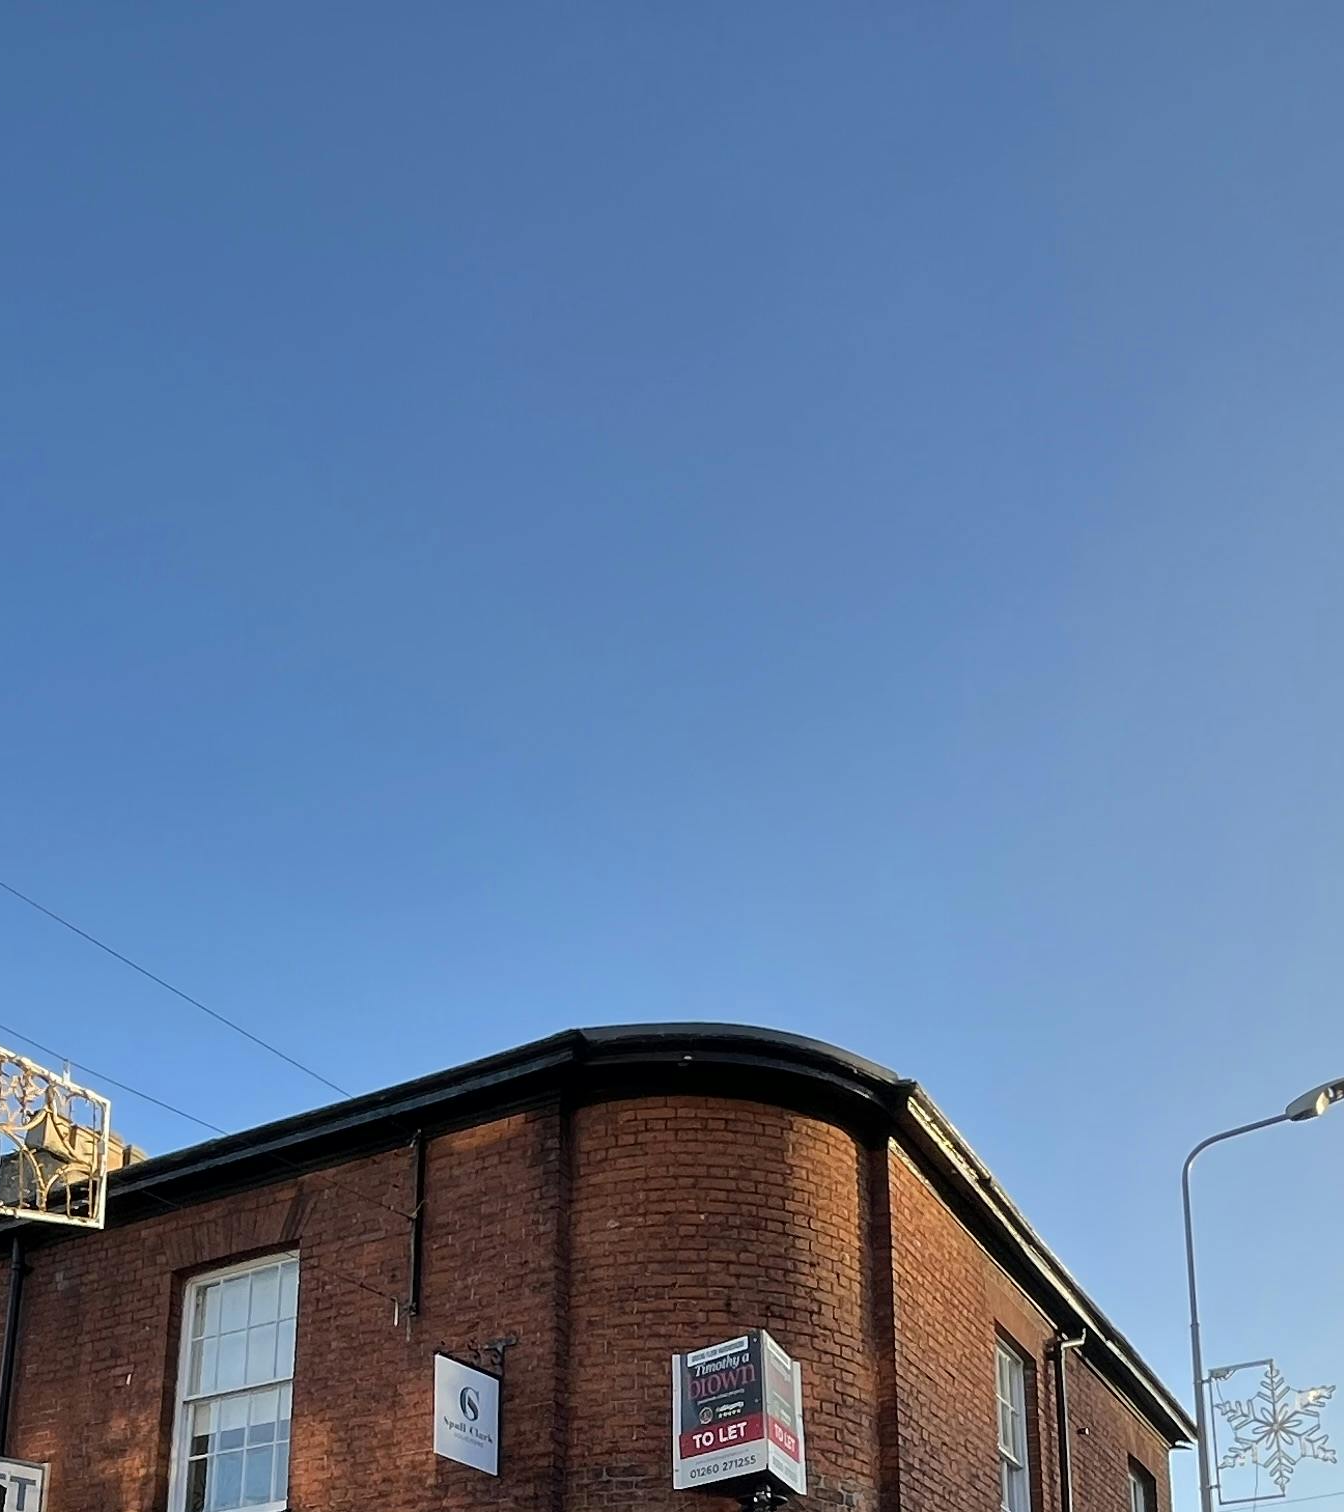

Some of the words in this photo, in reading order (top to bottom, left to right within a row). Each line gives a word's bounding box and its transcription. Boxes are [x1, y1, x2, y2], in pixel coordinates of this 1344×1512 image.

[694, 1354, 740, 1376] Timothy
[692, 1430, 714, 1449] TO
[719, 1421, 748, 1443] LET
[774, 1423, 783, 1442] TO
[784, 1431, 796, 1452] LET
[722, 1455, 757, 1472] 271255
